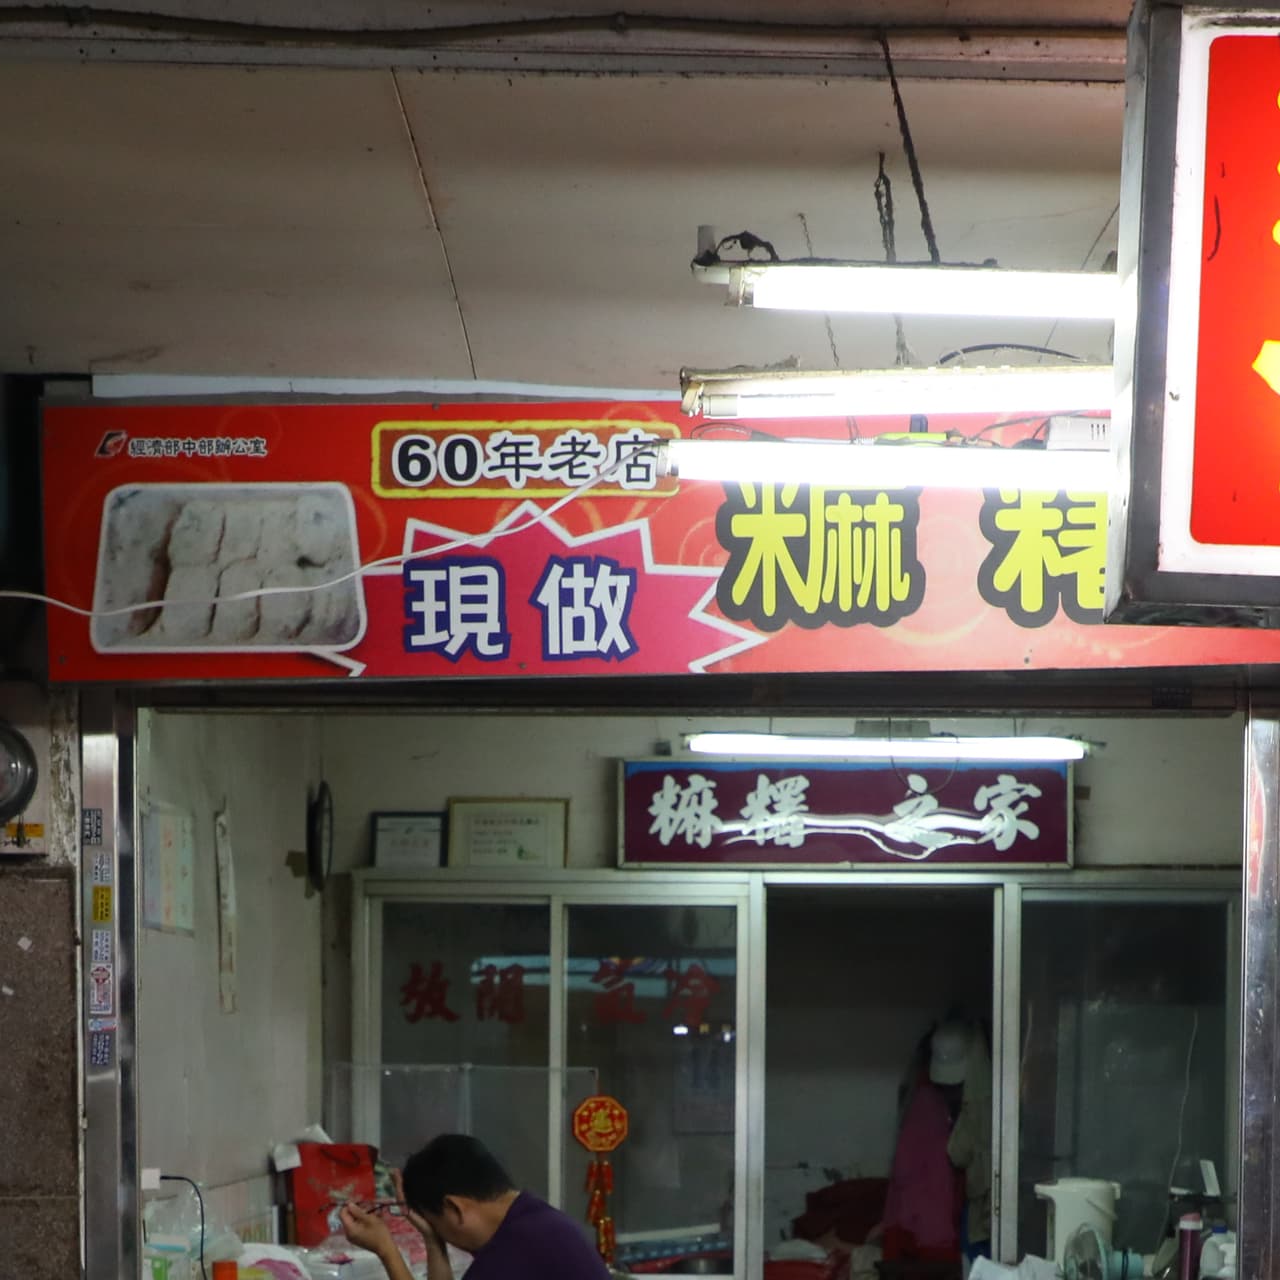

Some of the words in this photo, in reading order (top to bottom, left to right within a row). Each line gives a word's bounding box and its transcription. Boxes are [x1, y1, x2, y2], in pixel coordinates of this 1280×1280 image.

[130, 438, 267, 457] 經濟部中部辦公室
[392, 434, 663, 489] 60年老店
[409, 563, 635, 656] 現做
